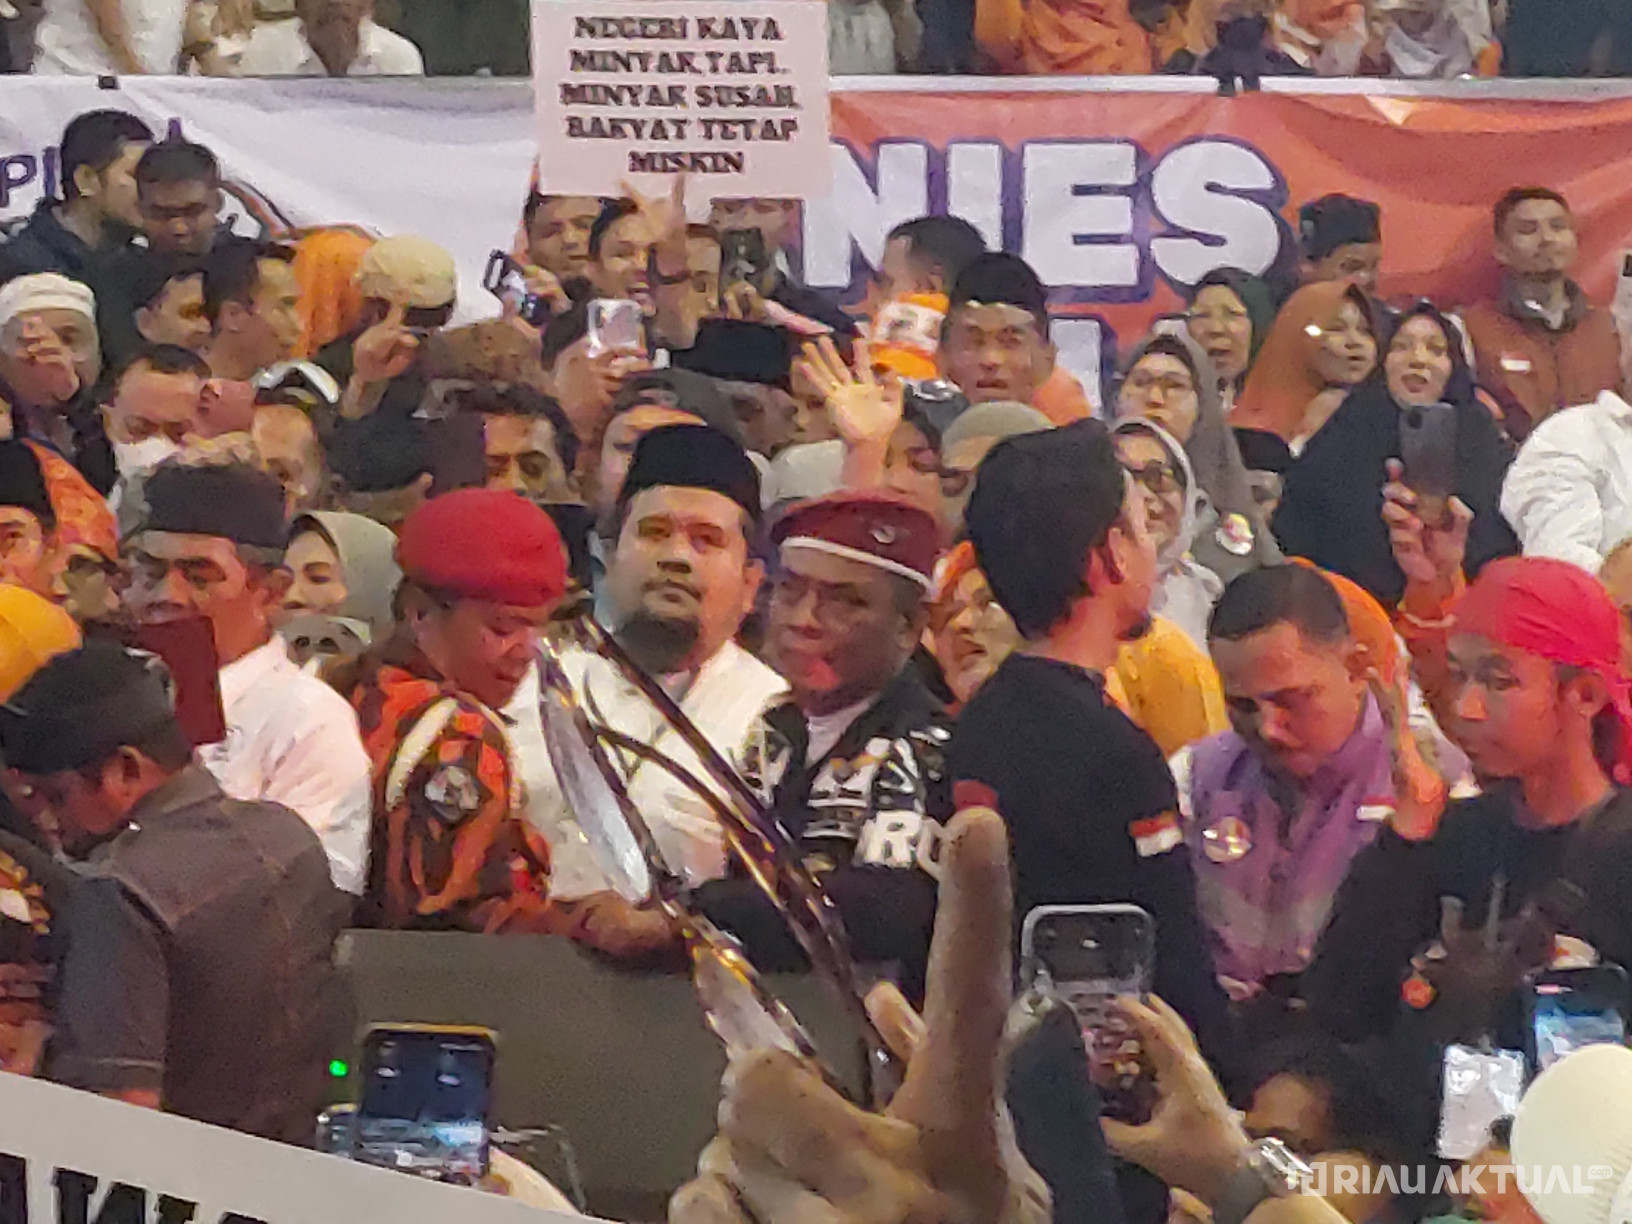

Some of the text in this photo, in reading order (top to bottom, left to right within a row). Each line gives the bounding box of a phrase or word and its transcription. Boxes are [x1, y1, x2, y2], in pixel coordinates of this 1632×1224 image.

[575, 16, 785, 40] NEGERI KAYA
[560, 83, 687, 107] MINYAK
[567, 116, 798, 141] RAKYAT TETAP
[628, 151, 744, 173] MISKIN
[801, 140, 1282, 295] NIES
